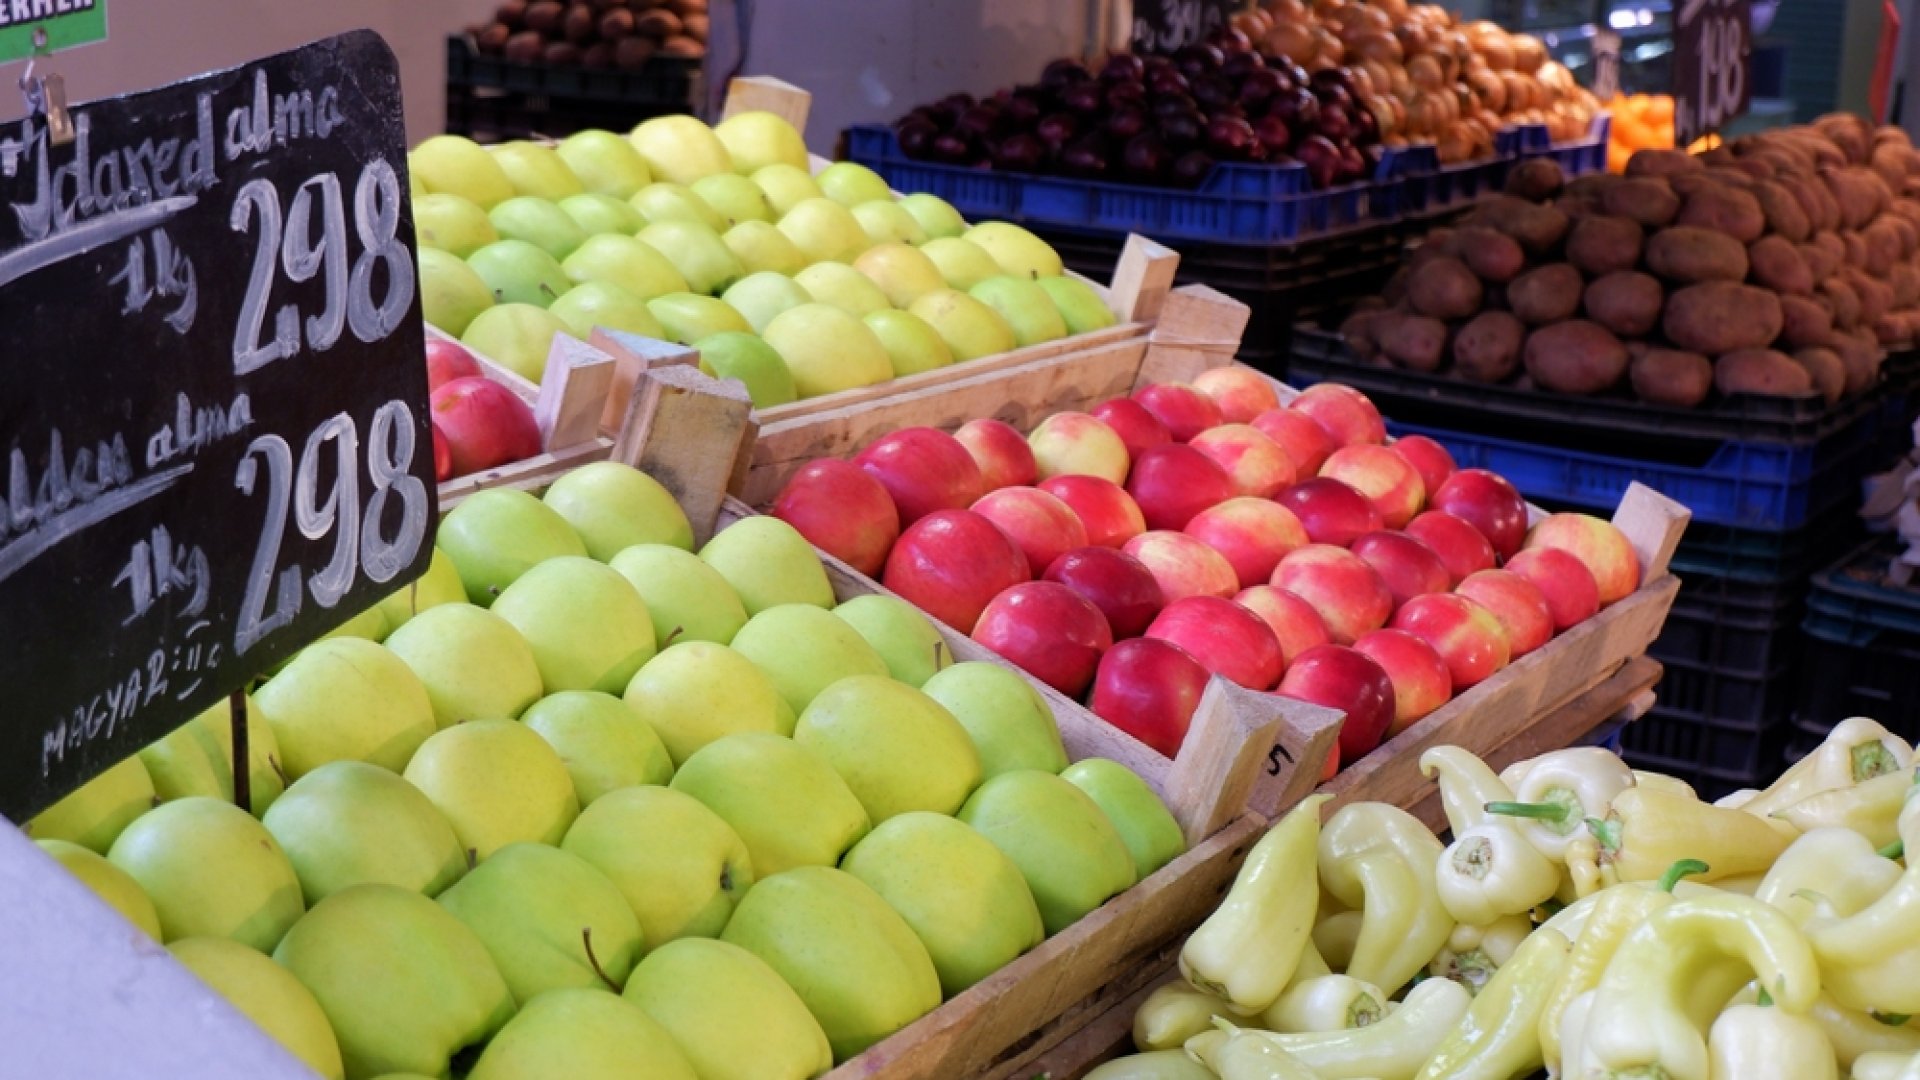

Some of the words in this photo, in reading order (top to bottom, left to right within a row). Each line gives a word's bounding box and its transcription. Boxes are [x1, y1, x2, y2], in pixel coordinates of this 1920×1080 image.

[223, 68, 344, 160] alma
[107, 228, 198, 335] 1kg
[230, 157, 414, 376] 298
[146, 392, 254, 469] alma
[112, 523, 211, 626] 1kg
[234, 400, 429, 657] 298
[1267, 743, 1295, 777] 5
